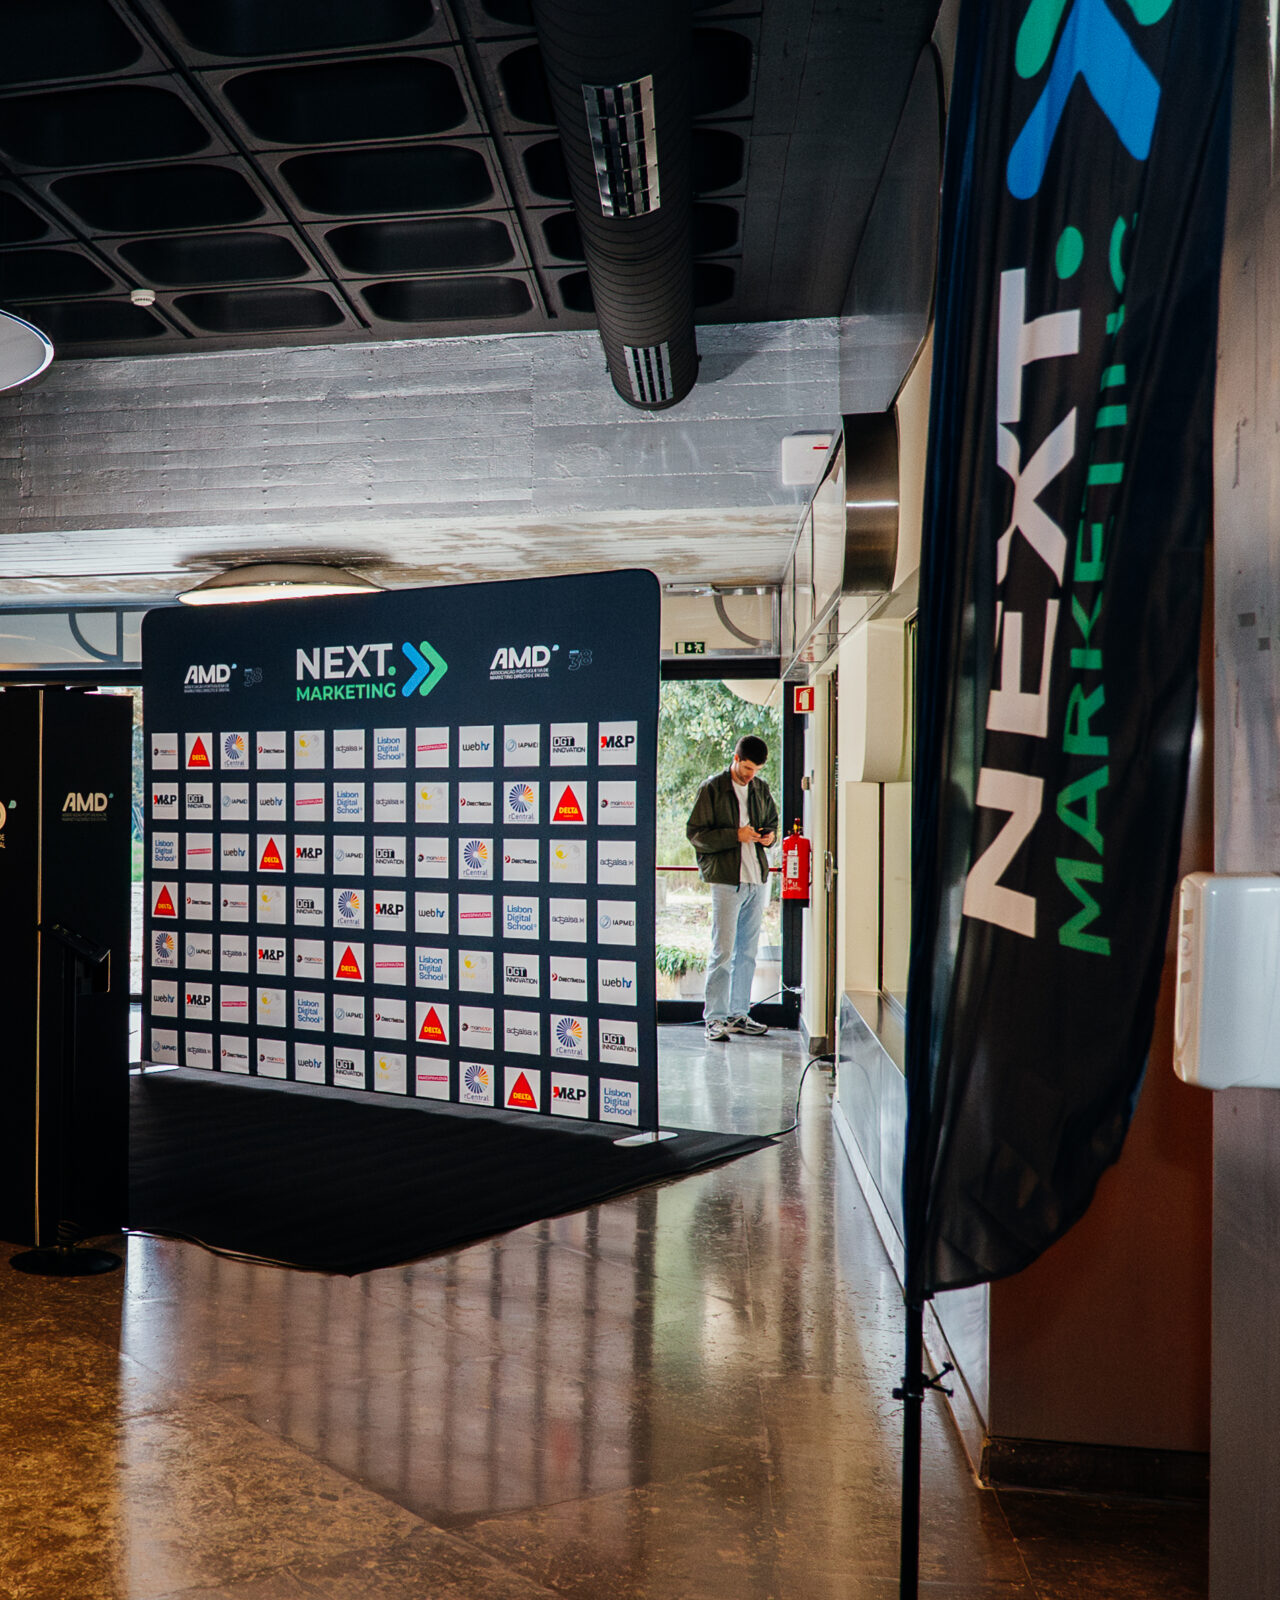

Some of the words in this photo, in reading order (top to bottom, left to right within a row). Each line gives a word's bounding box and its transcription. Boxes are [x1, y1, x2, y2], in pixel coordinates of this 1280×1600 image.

[1056, 212, 1138, 956] MARKET
[296, 643, 396, 681] NEXT.
[490, 645, 551, 670] AMD
[184, 664, 231, 684] AMD
[296, 682, 396, 701] MARKETING
[554, 737, 572, 747] DGT
[377, 745, 399, 753] Digital
[62, 792, 108, 812] AMD
[376, 849, 393, 858] DGT
[297, 899, 312, 908] DGT
[507, 905, 532, 913] Lisbon
[507, 914, 531, 923] Digital
[507, 922, 533, 931] School
[419, 956, 443, 964] Lisbon
[419, 964, 441, 973] Digital
[507, 967, 525, 977] DGT
[419, 972, 443, 981] School
[298, 999, 319, 1008] Lisbon
[298, 1007, 318, 1016] Digital
[298, 1014, 320, 1024] School
[424, 1026, 441, 1034] DELTA
[603, 1033, 622, 1044] DGT
[337, 1060, 352, 1070] DGT
[513, 1092, 532, 1101] DELTA
[604, 1088, 631, 1098] Lisbon
[604, 1096, 629, 1108] Digital
[604, 1105, 632, 1116] School
